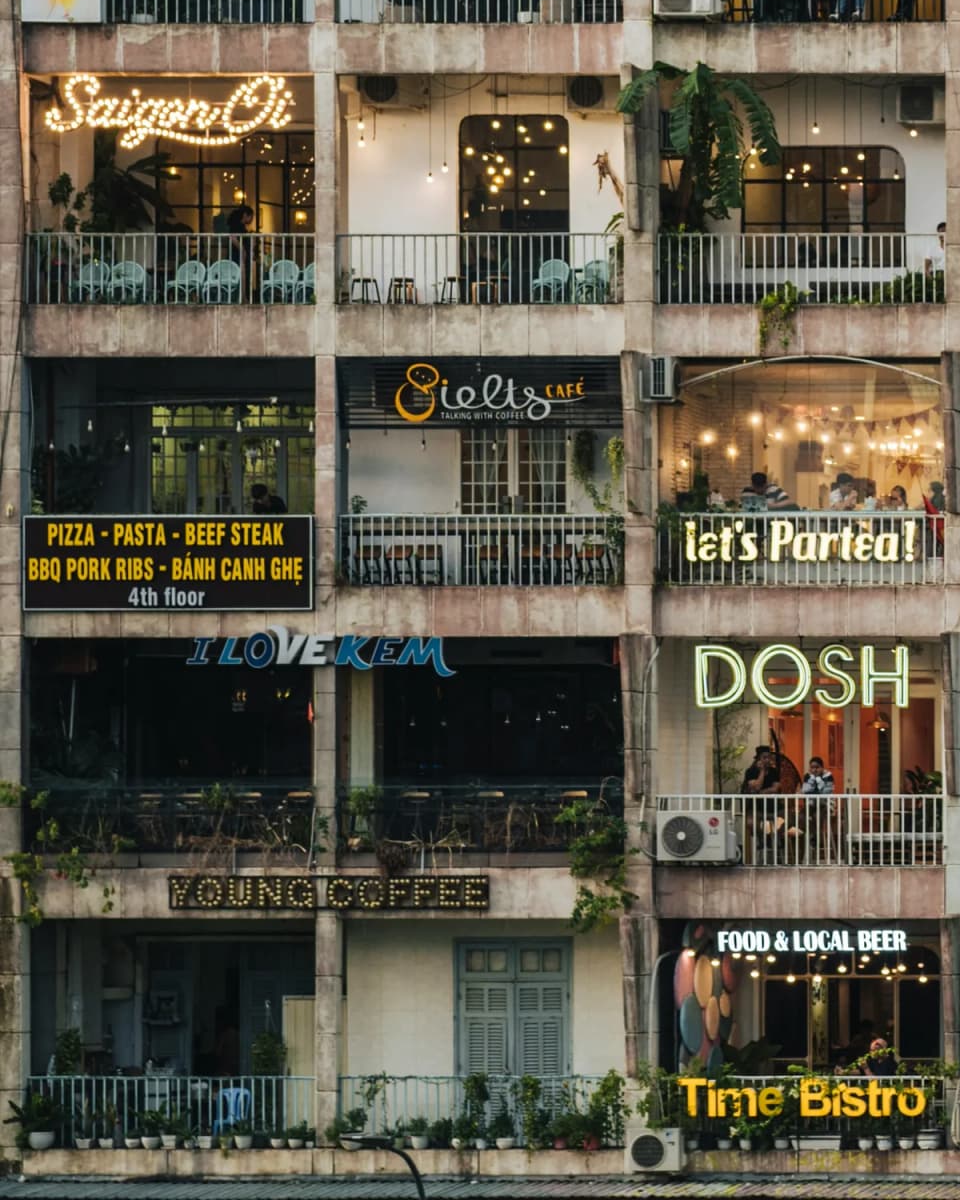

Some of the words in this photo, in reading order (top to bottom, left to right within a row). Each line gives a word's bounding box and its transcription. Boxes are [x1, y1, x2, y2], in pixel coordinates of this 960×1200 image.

[440, 412, 472, 420] TALKING
[474, 412, 493, 420] WITH
[495, 411, 525, 420] COFFEE
[47, 523, 95, 546] PIZZA
[113, 523, 167, 546] PASTA
[184, 523, 226, 546] BEEF
[231, 523, 284, 546] STEAK
[28, 557, 62, 583] BBQ
[66, 558, 111, 581] PORK
[116, 558, 154, 581] RIBS
[171, 552, 216, 581] BÁNH
[221, 558, 266, 581] CANH
[271, 557, 303, 586] GHẸ
[128, 587, 158, 606] 4th
[164, 587, 205, 606] floor
[186, 637, 215, 665] I
[217, 624, 334, 669] LOVE
[335, 634, 457, 678] KEM
[695, 644, 908, 708] DOSH
[169, 878, 313, 908] YOUNG
[326, 878, 488, 908] COFFEE
[717, 931, 770, 952] FOOD
[774, 930, 789, 951] &
[792, 930, 854, 951] LOCAL
[857, 930, 907, 951] BEER
[676, 1077, 784, 1118] Time
[800, 1077, 927, 1117] Bistro
